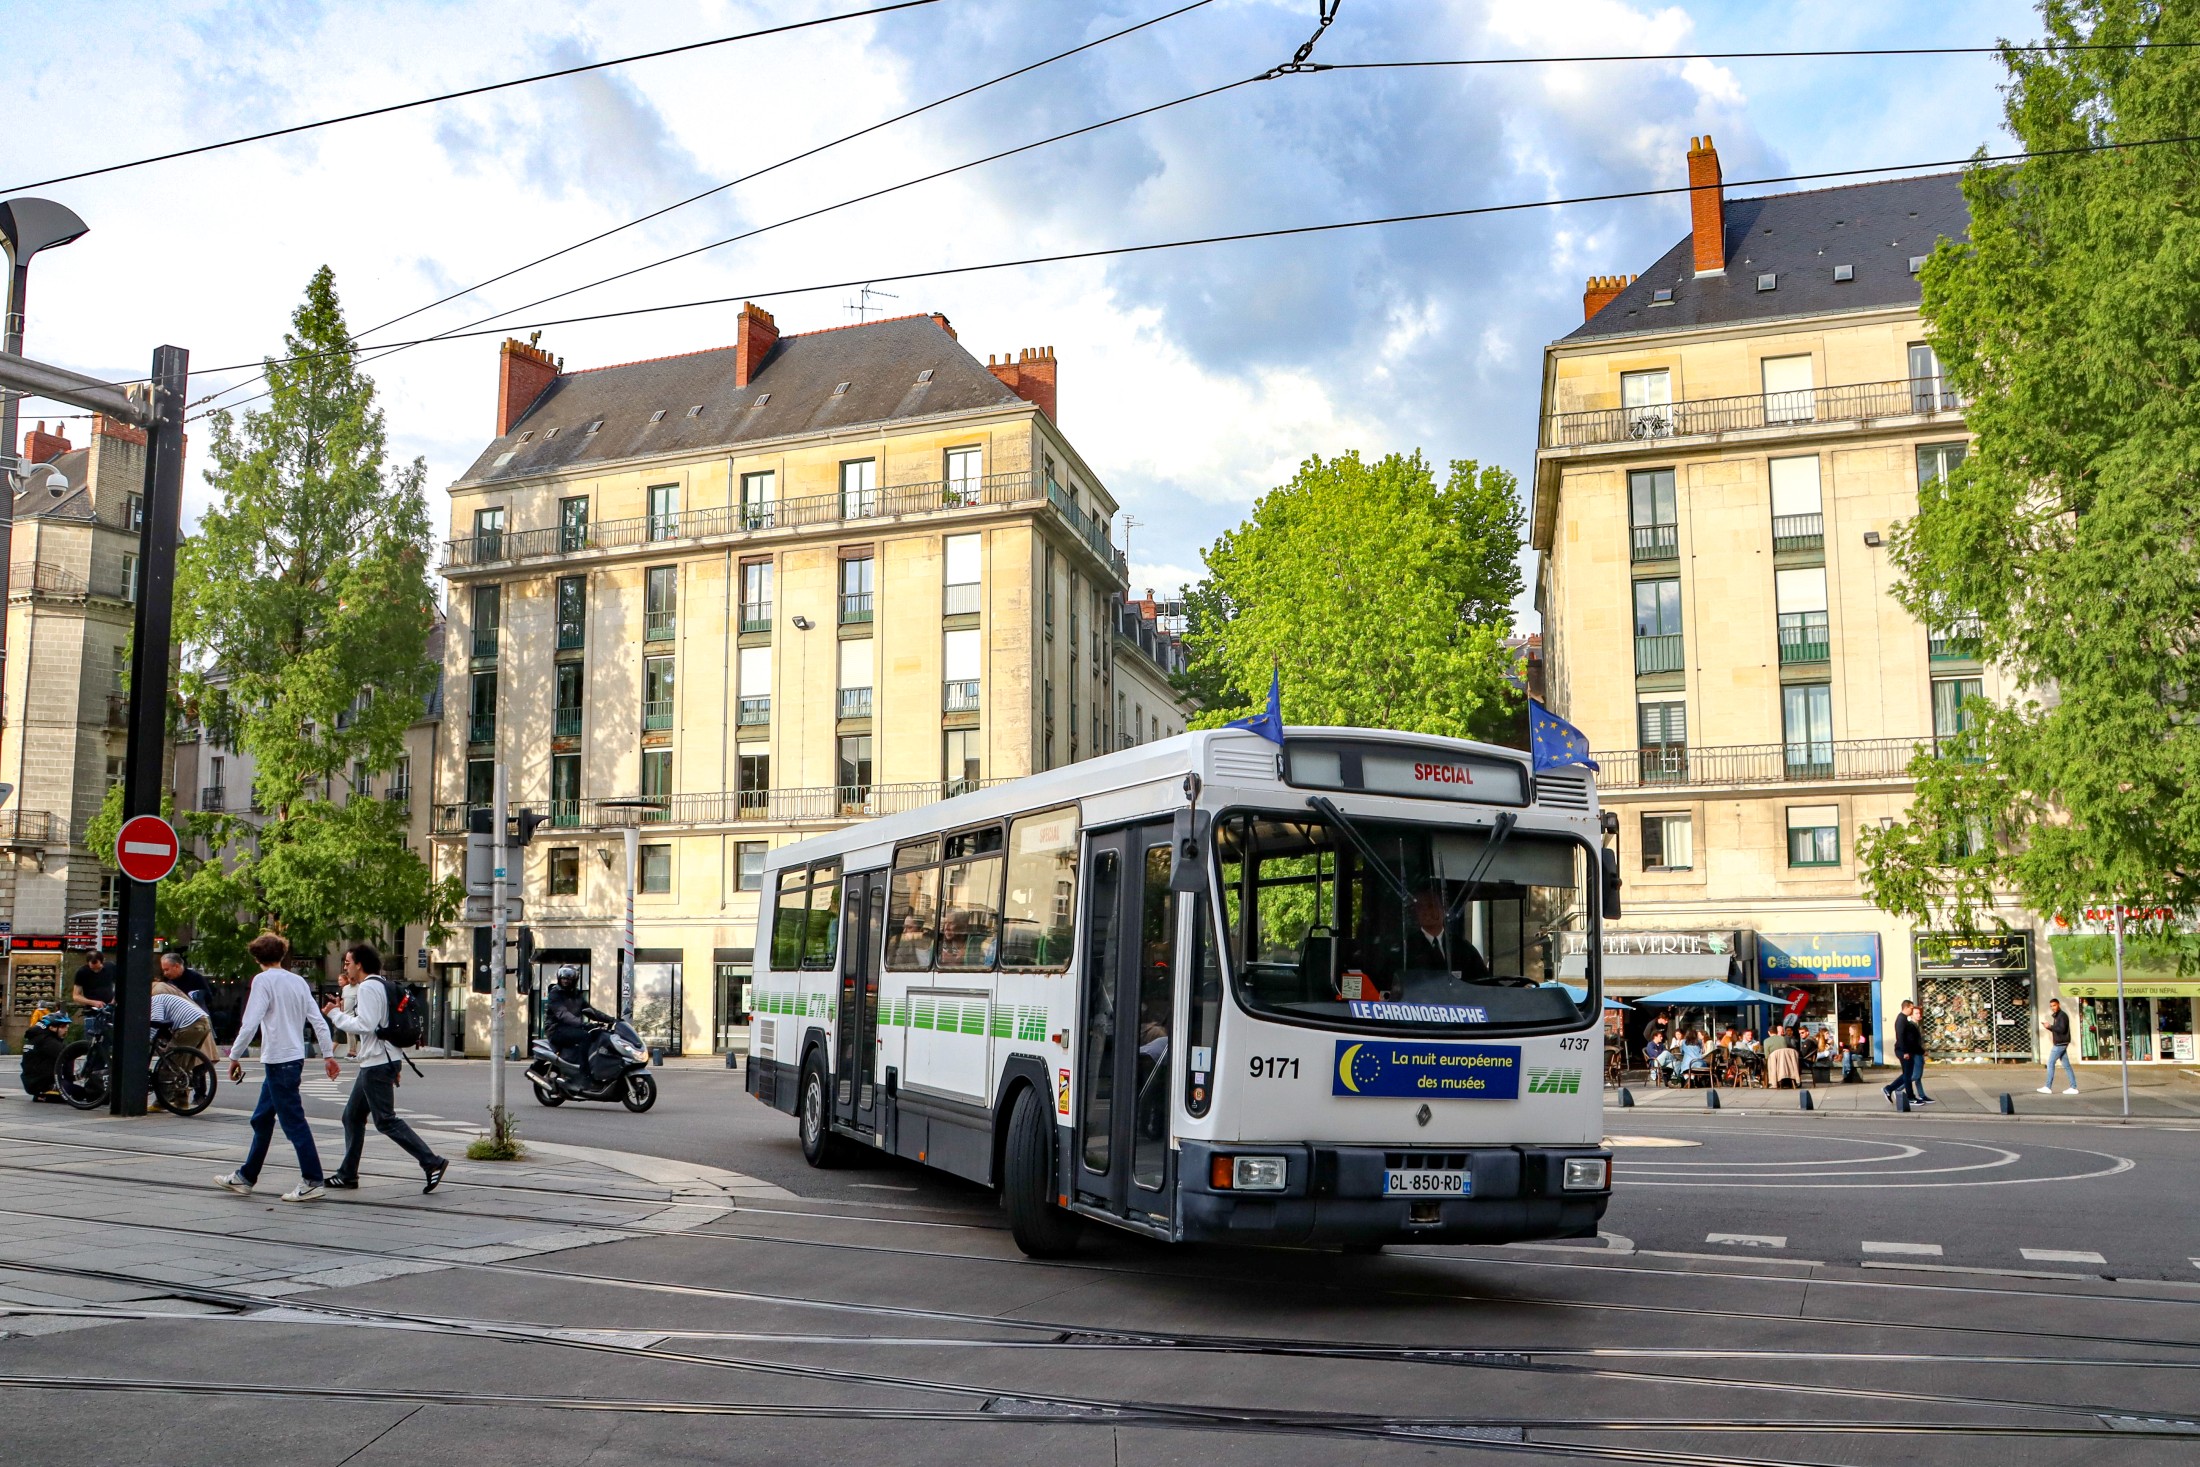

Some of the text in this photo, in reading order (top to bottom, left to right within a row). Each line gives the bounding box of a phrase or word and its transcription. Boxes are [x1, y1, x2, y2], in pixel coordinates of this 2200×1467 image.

[1414, 762, 1474, 785] SPECIAL
[1635, 934, 1701, 955] VERTE
[2159, 986, 2178, 994] NÉPAL
[1352, 1003, 1487, 1022] LE CHRONOGRAPHE
[1017, 1004, 1048, 1042] TAN
[1560, 1038, 1590, 1051] 4737
[1198, 1052, 1203, 1067] 1
[1249, 1056, 1300, 1079] 9171
[1392, 1051, 1513, 1069] La nuit européenne
[1417, 1075, 1486, 1090] des musées
[1527, 1066, 1583, 1094] TAN
[1390, 1174, 1462, 1190] CL-850-RD
